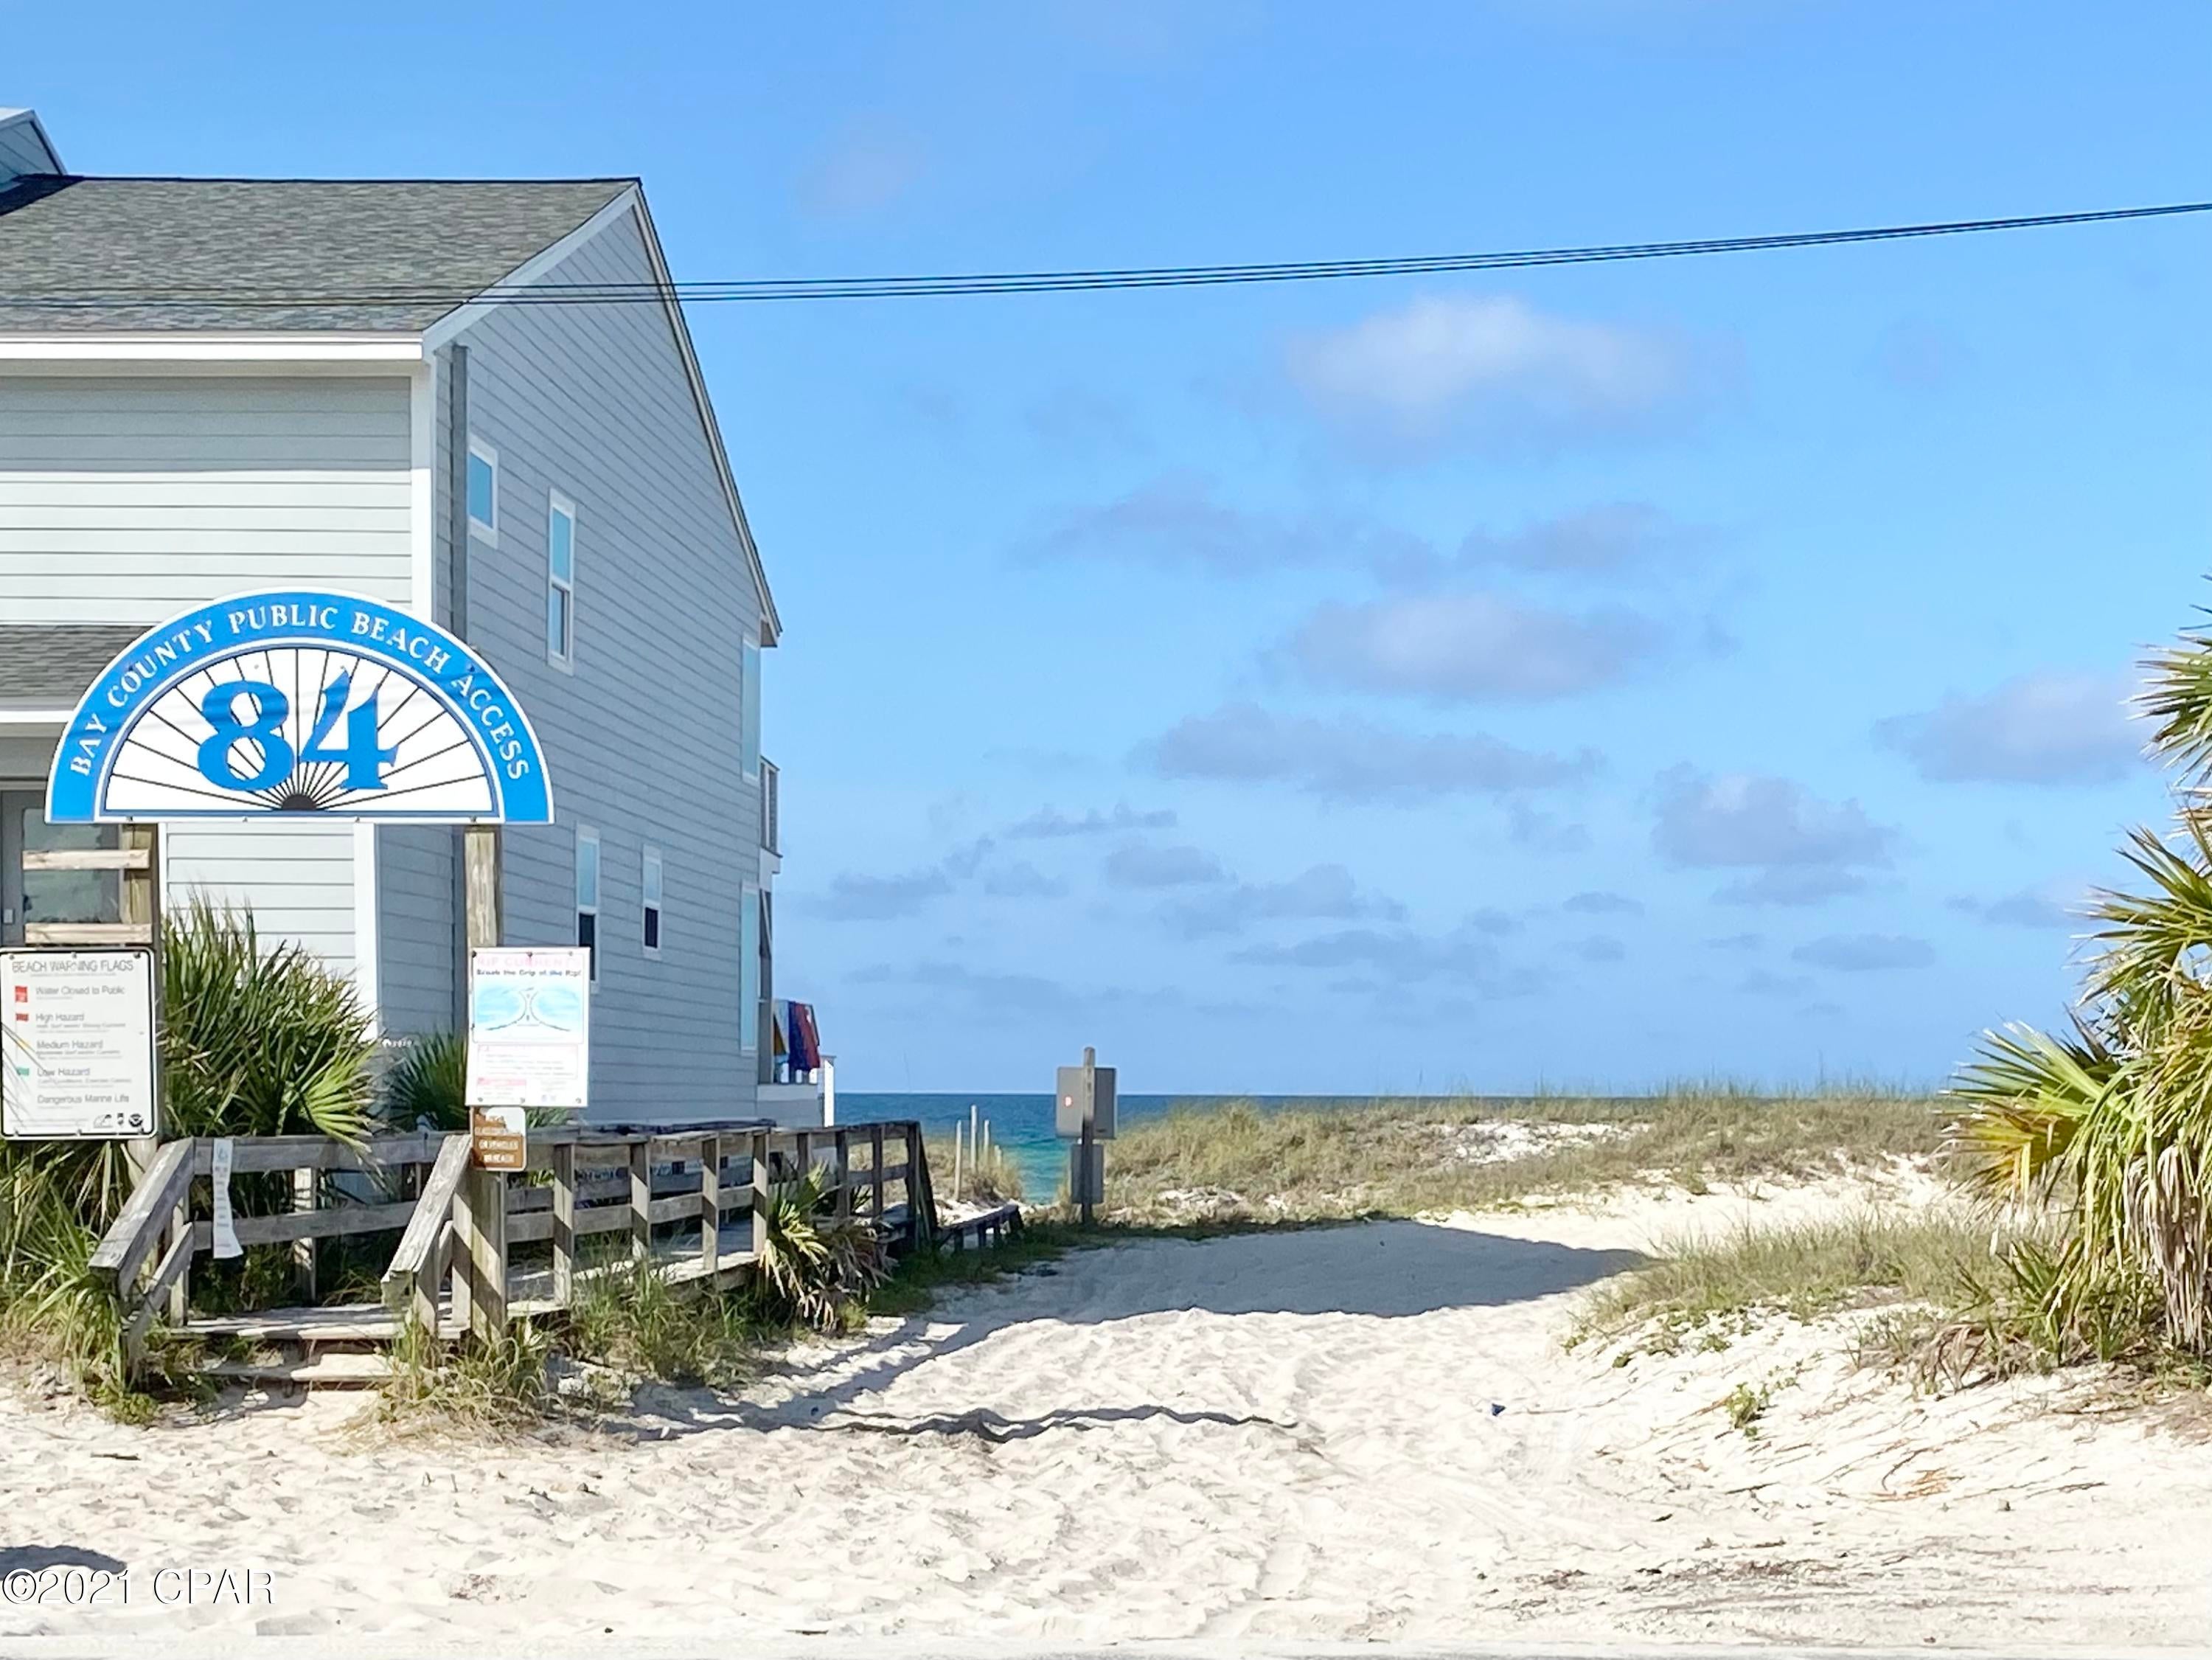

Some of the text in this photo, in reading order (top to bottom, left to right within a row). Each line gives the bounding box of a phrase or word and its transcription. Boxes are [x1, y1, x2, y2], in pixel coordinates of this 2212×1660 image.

[70, 603, 530, 779] BAY COUNTY PUBLIC BEACH ACCESS
[197, 667, 399, 791] 84
[12, 960, 47, 973] BEACH
[100, 959, 134, 971] FLAGS
[61, 985, 89, 995] Closed
[72, 1039, 103, 1049] Hazard
[37, 1094, 83, 1105] Dangerous
